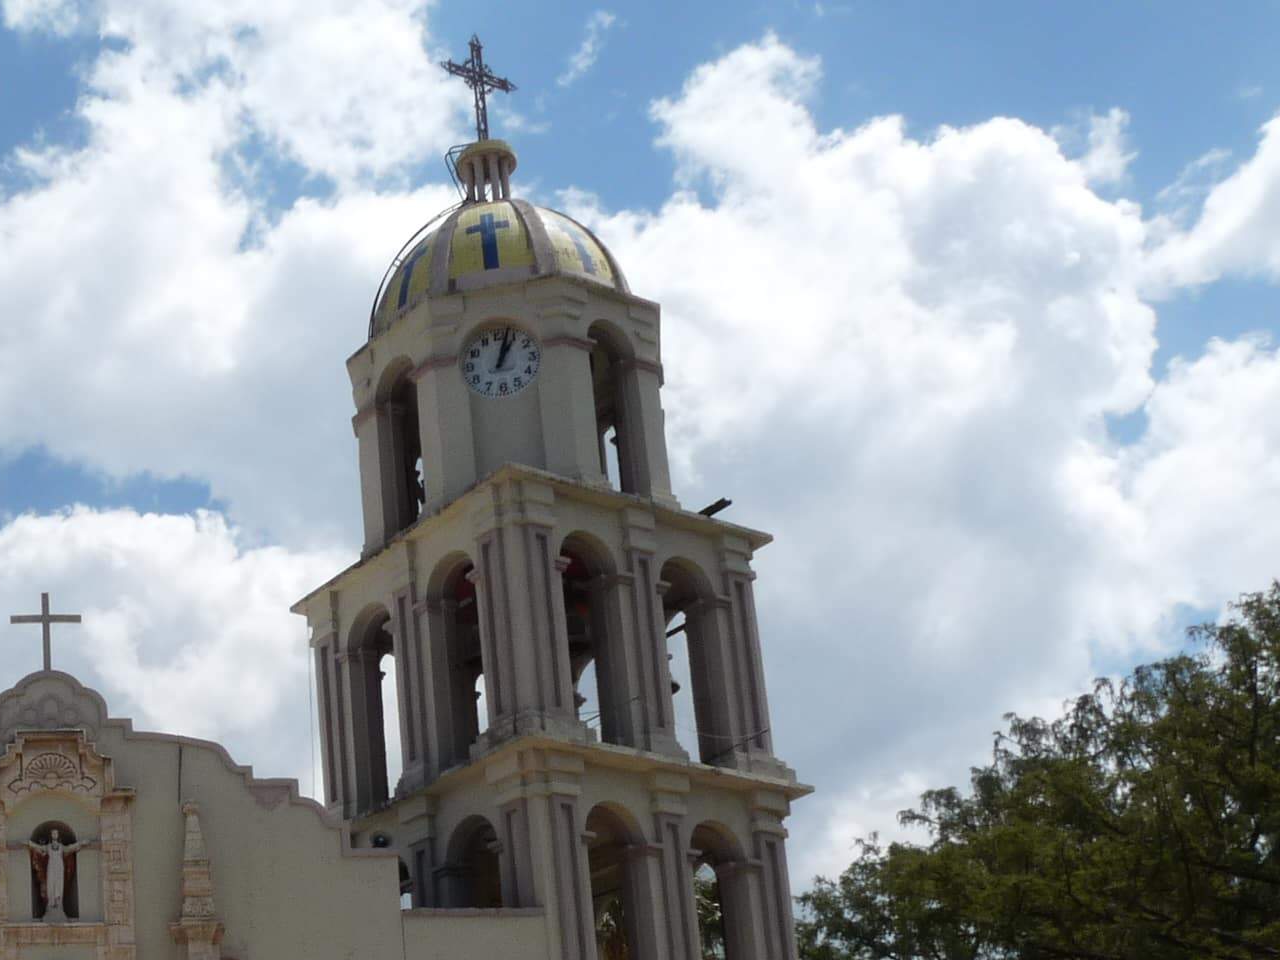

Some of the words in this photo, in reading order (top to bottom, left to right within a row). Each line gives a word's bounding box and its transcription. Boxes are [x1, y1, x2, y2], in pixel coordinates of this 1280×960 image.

[493, 330, 505, 342] 12
[481, 338, 489, 347] 11
[522, 339, 530, 348] 2
[470, 349, 480, 359] 10
[528, 351, 537, 361] 3
[466, 362, 474, 372] 9
[524, 365, 531, 374] 4
[472, 375, 480, 384] 8
[513, 377, 522, 387] 5
[485, 382, 493, 392] 7
[500, 383, 507, 392] 6
